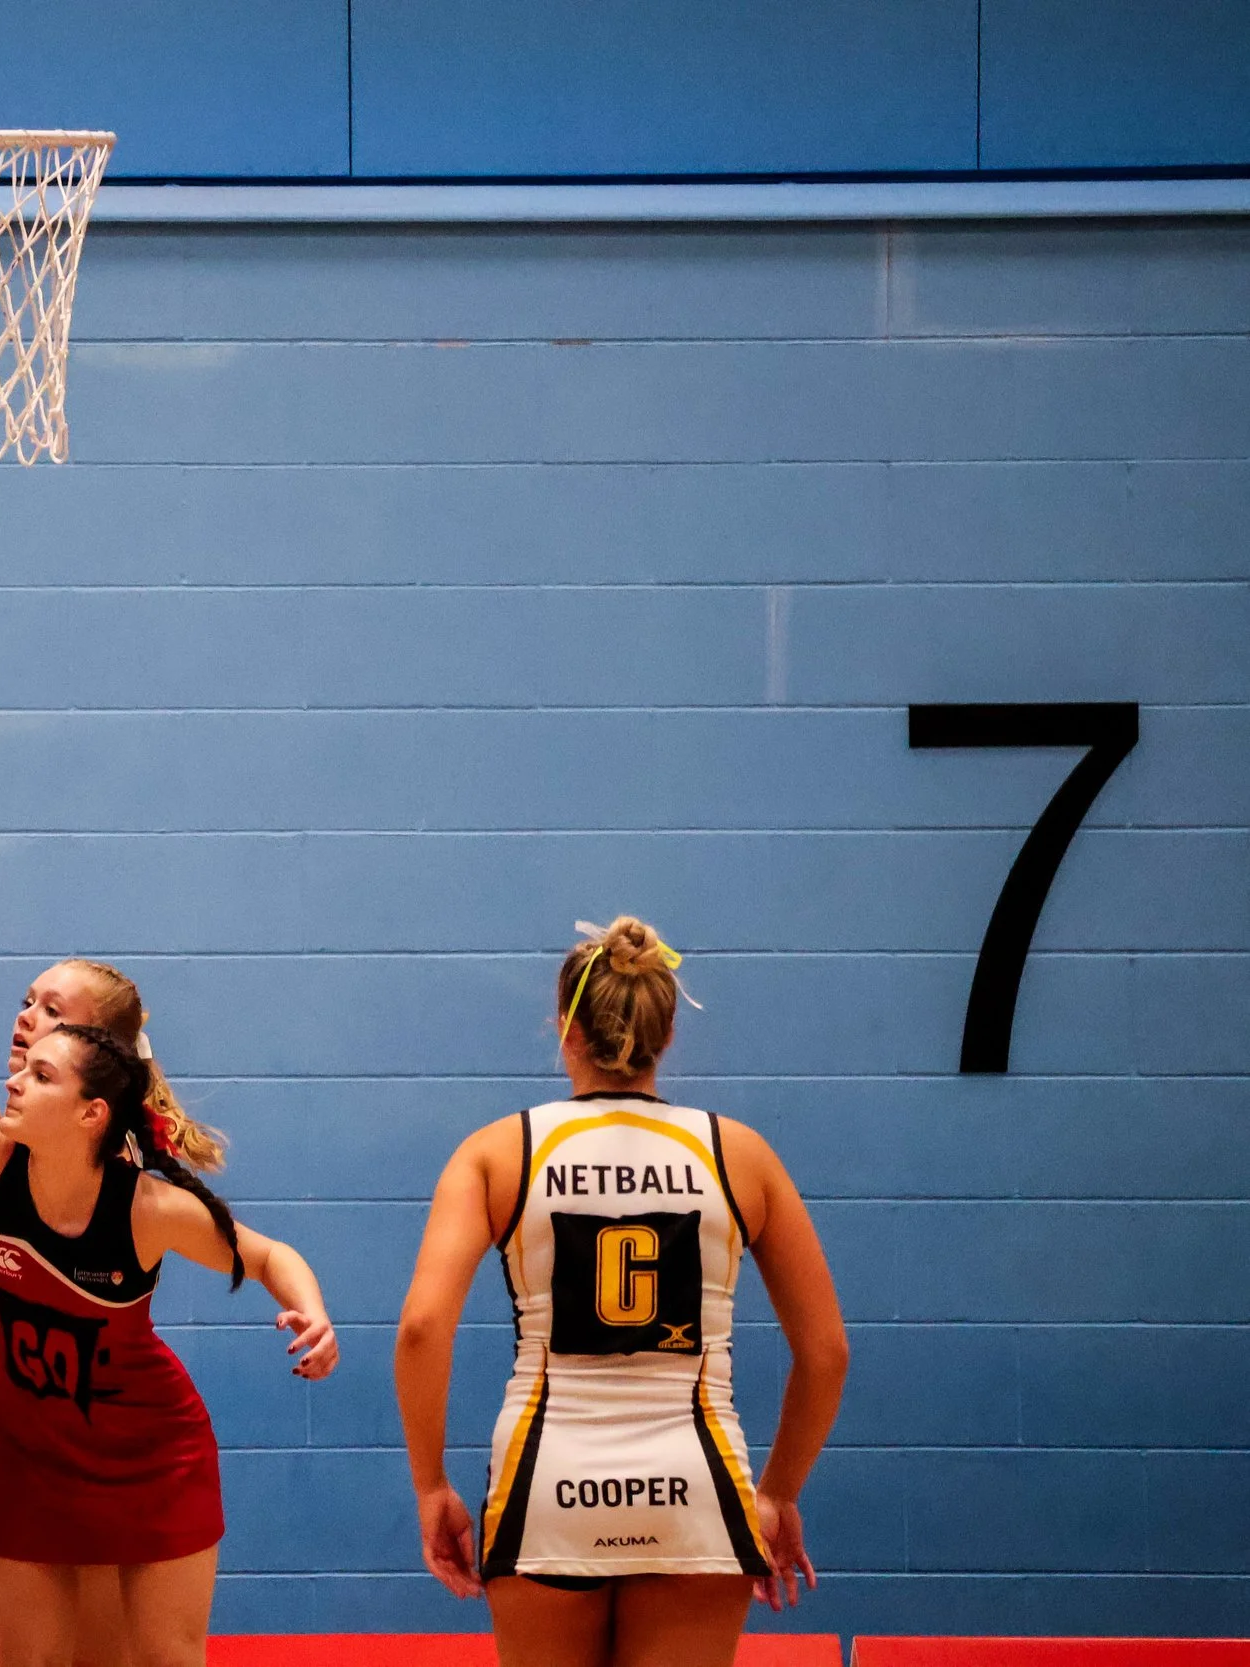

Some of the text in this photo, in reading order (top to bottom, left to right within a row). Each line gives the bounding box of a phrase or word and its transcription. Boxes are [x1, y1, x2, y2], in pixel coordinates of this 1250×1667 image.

[908, 702, 1139, 1073] 7
[546, 1164, 704, 1197] NETBALL
[595, 1224, 660, 1327] C
[556, 1476, 689, 1509] COOPER
[593, 1536, 660, 1548] AKUMA
